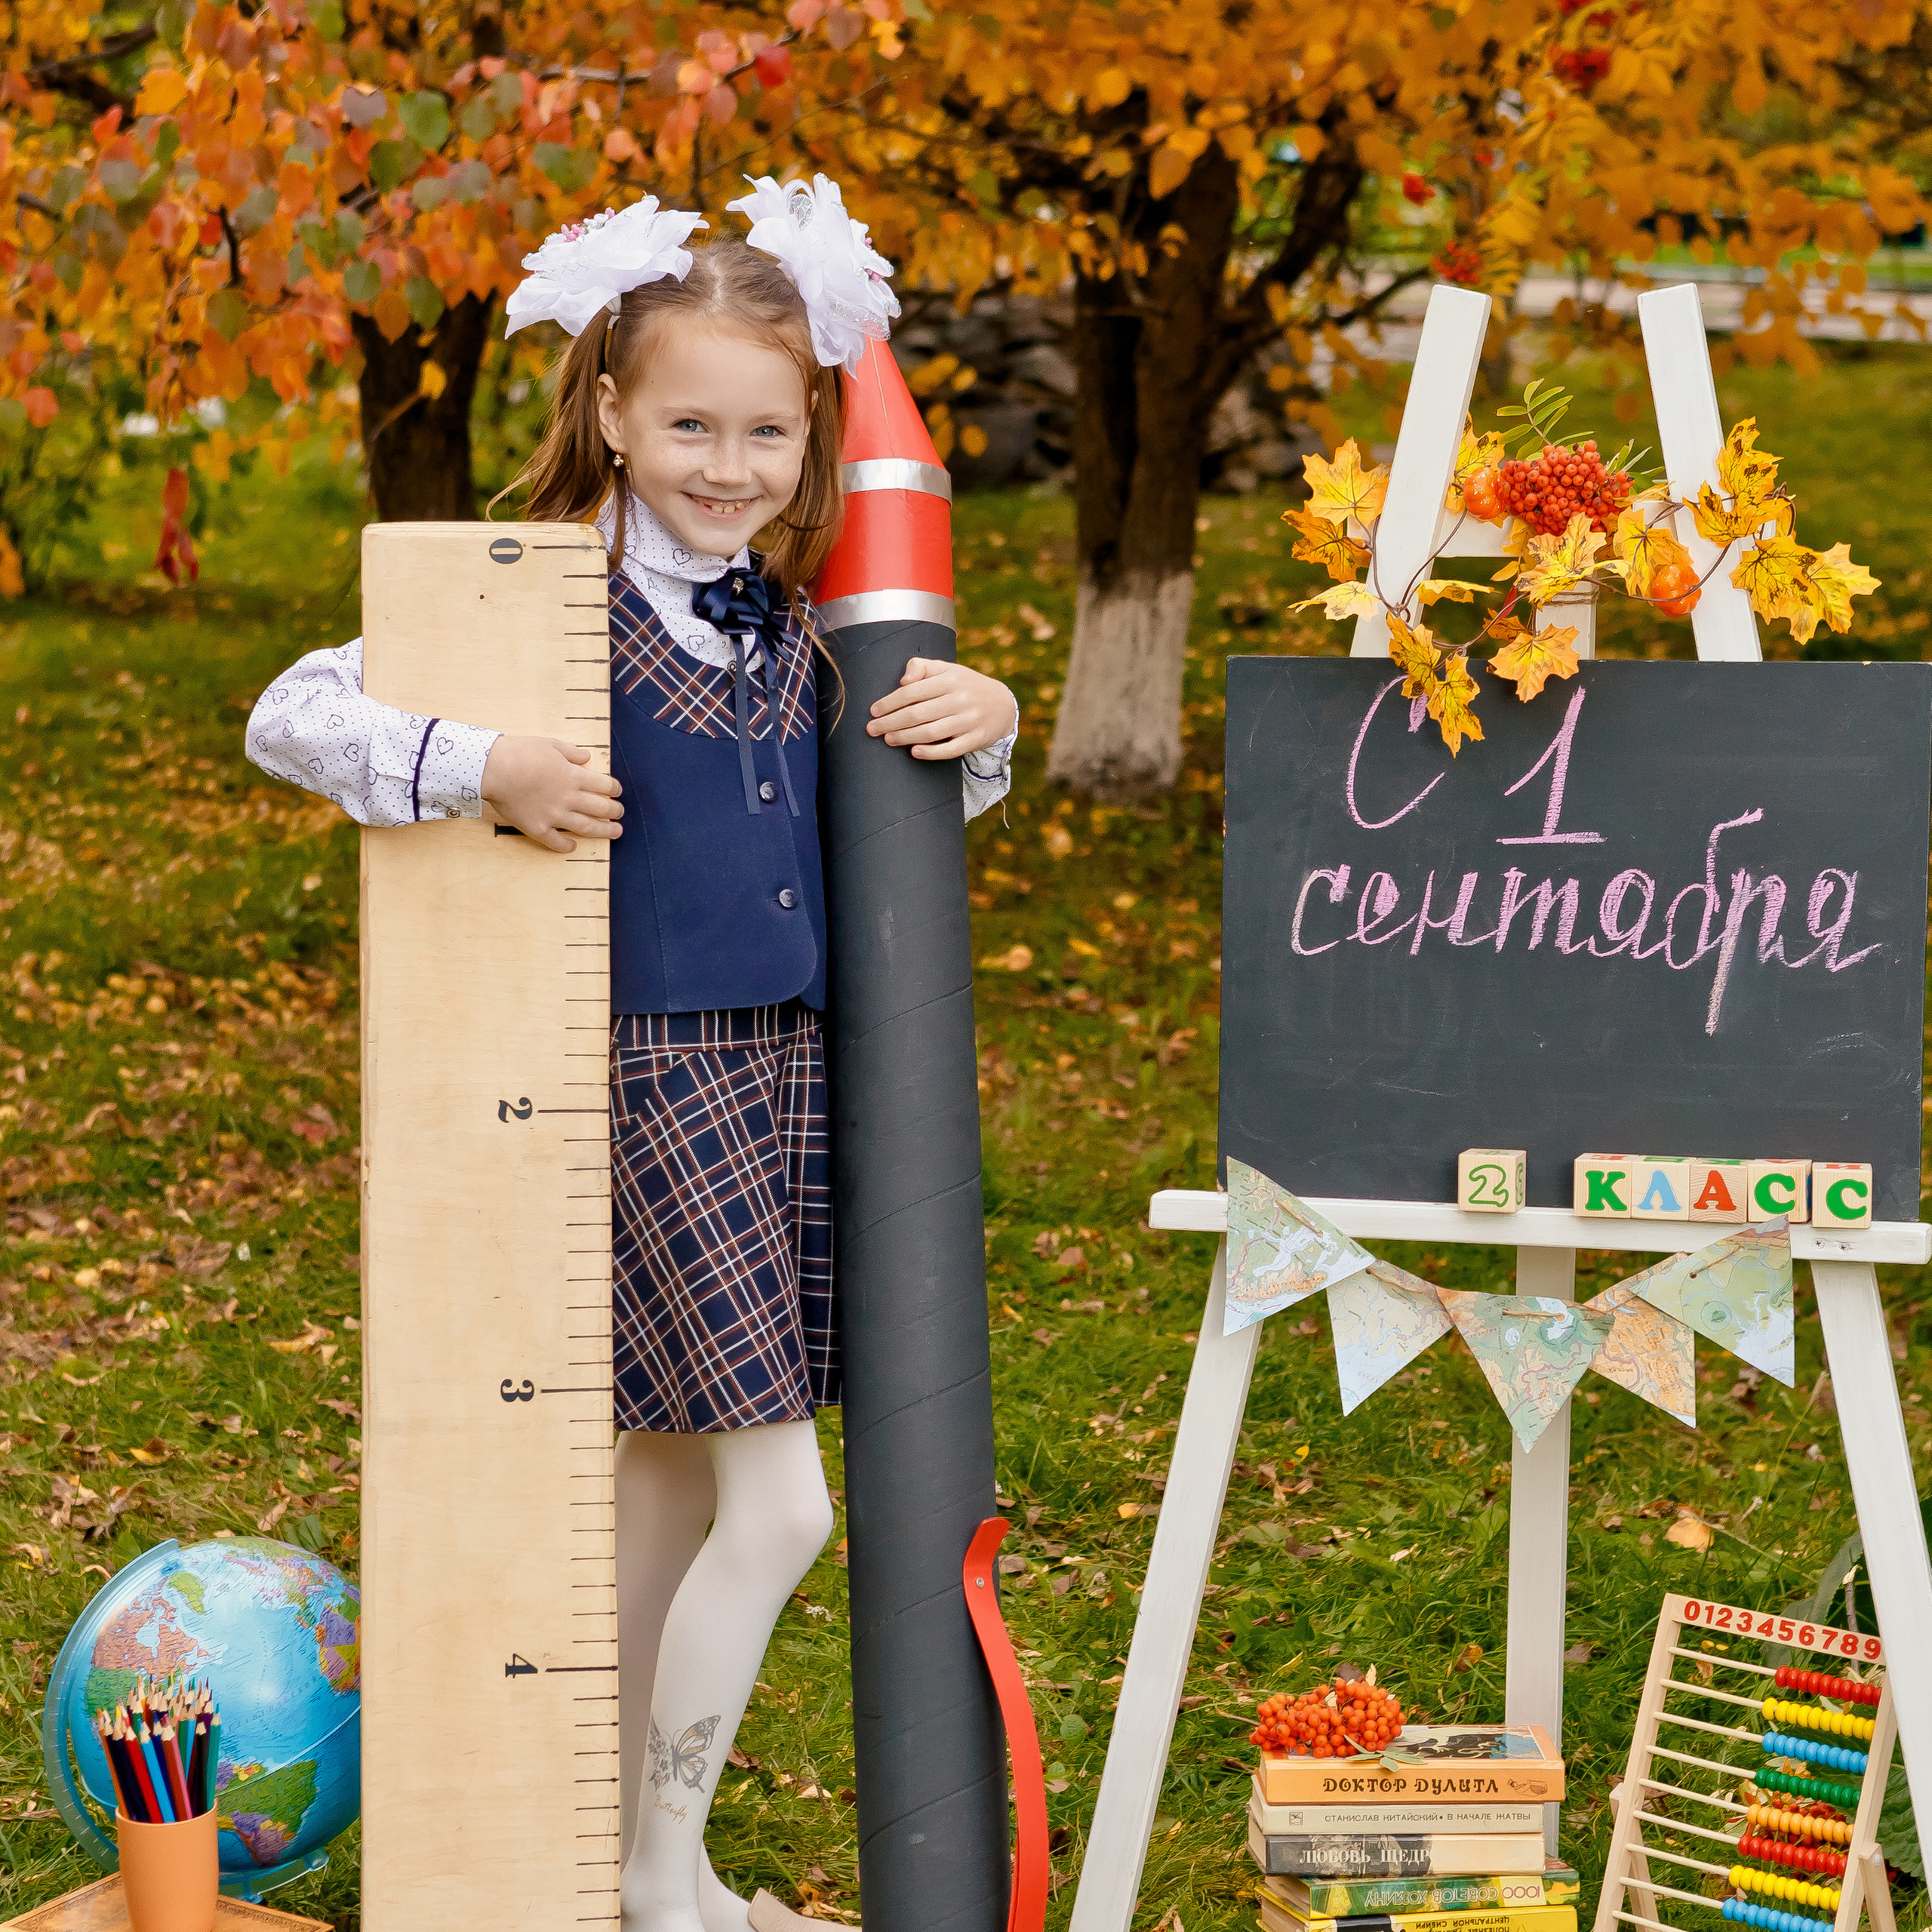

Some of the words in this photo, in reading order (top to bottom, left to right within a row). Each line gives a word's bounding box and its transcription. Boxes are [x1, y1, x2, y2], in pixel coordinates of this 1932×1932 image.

[489, 538, 523, 564] 0
[1346, 674, 1445, 829] С
[1496, 685, 1608, 844] 1
[498, 1097, 532, 1123] 2
[1469, 1164, 1509, 1207] 2
[1585, 1170, 1868, 1220] КЛАСС
[500, 1379, 534, 1402] 3
[505, 1653, 538, 1679] 4
[1323, 1778, 1407, 1792] ДОКТОР
[1414, 1778, 1499, 1795] ДУЛИТЛ
[1324, 1814, 1380, 1823] СТАНИСЛАВ
[1457, 1813, 1491, 1821] НАЧАЛЕ
[1496, 1813, 1531, 1821] ЖАТВЫ
[1299, 1849, 1371, 1864] ЛЮБОВЬ
[1364, 1889, 1430, 1908] ХОЗЯИНУ
[1432, 1887, 1498, 1905] СОВЕТОВ
[1503, 1884, 1540, 1900] 1000
[1416, 1920, 1447, 1929] СИБИРИ
[1453, 1916, 1509, 1927] ЦЕНТРАЛЬНОЙ
